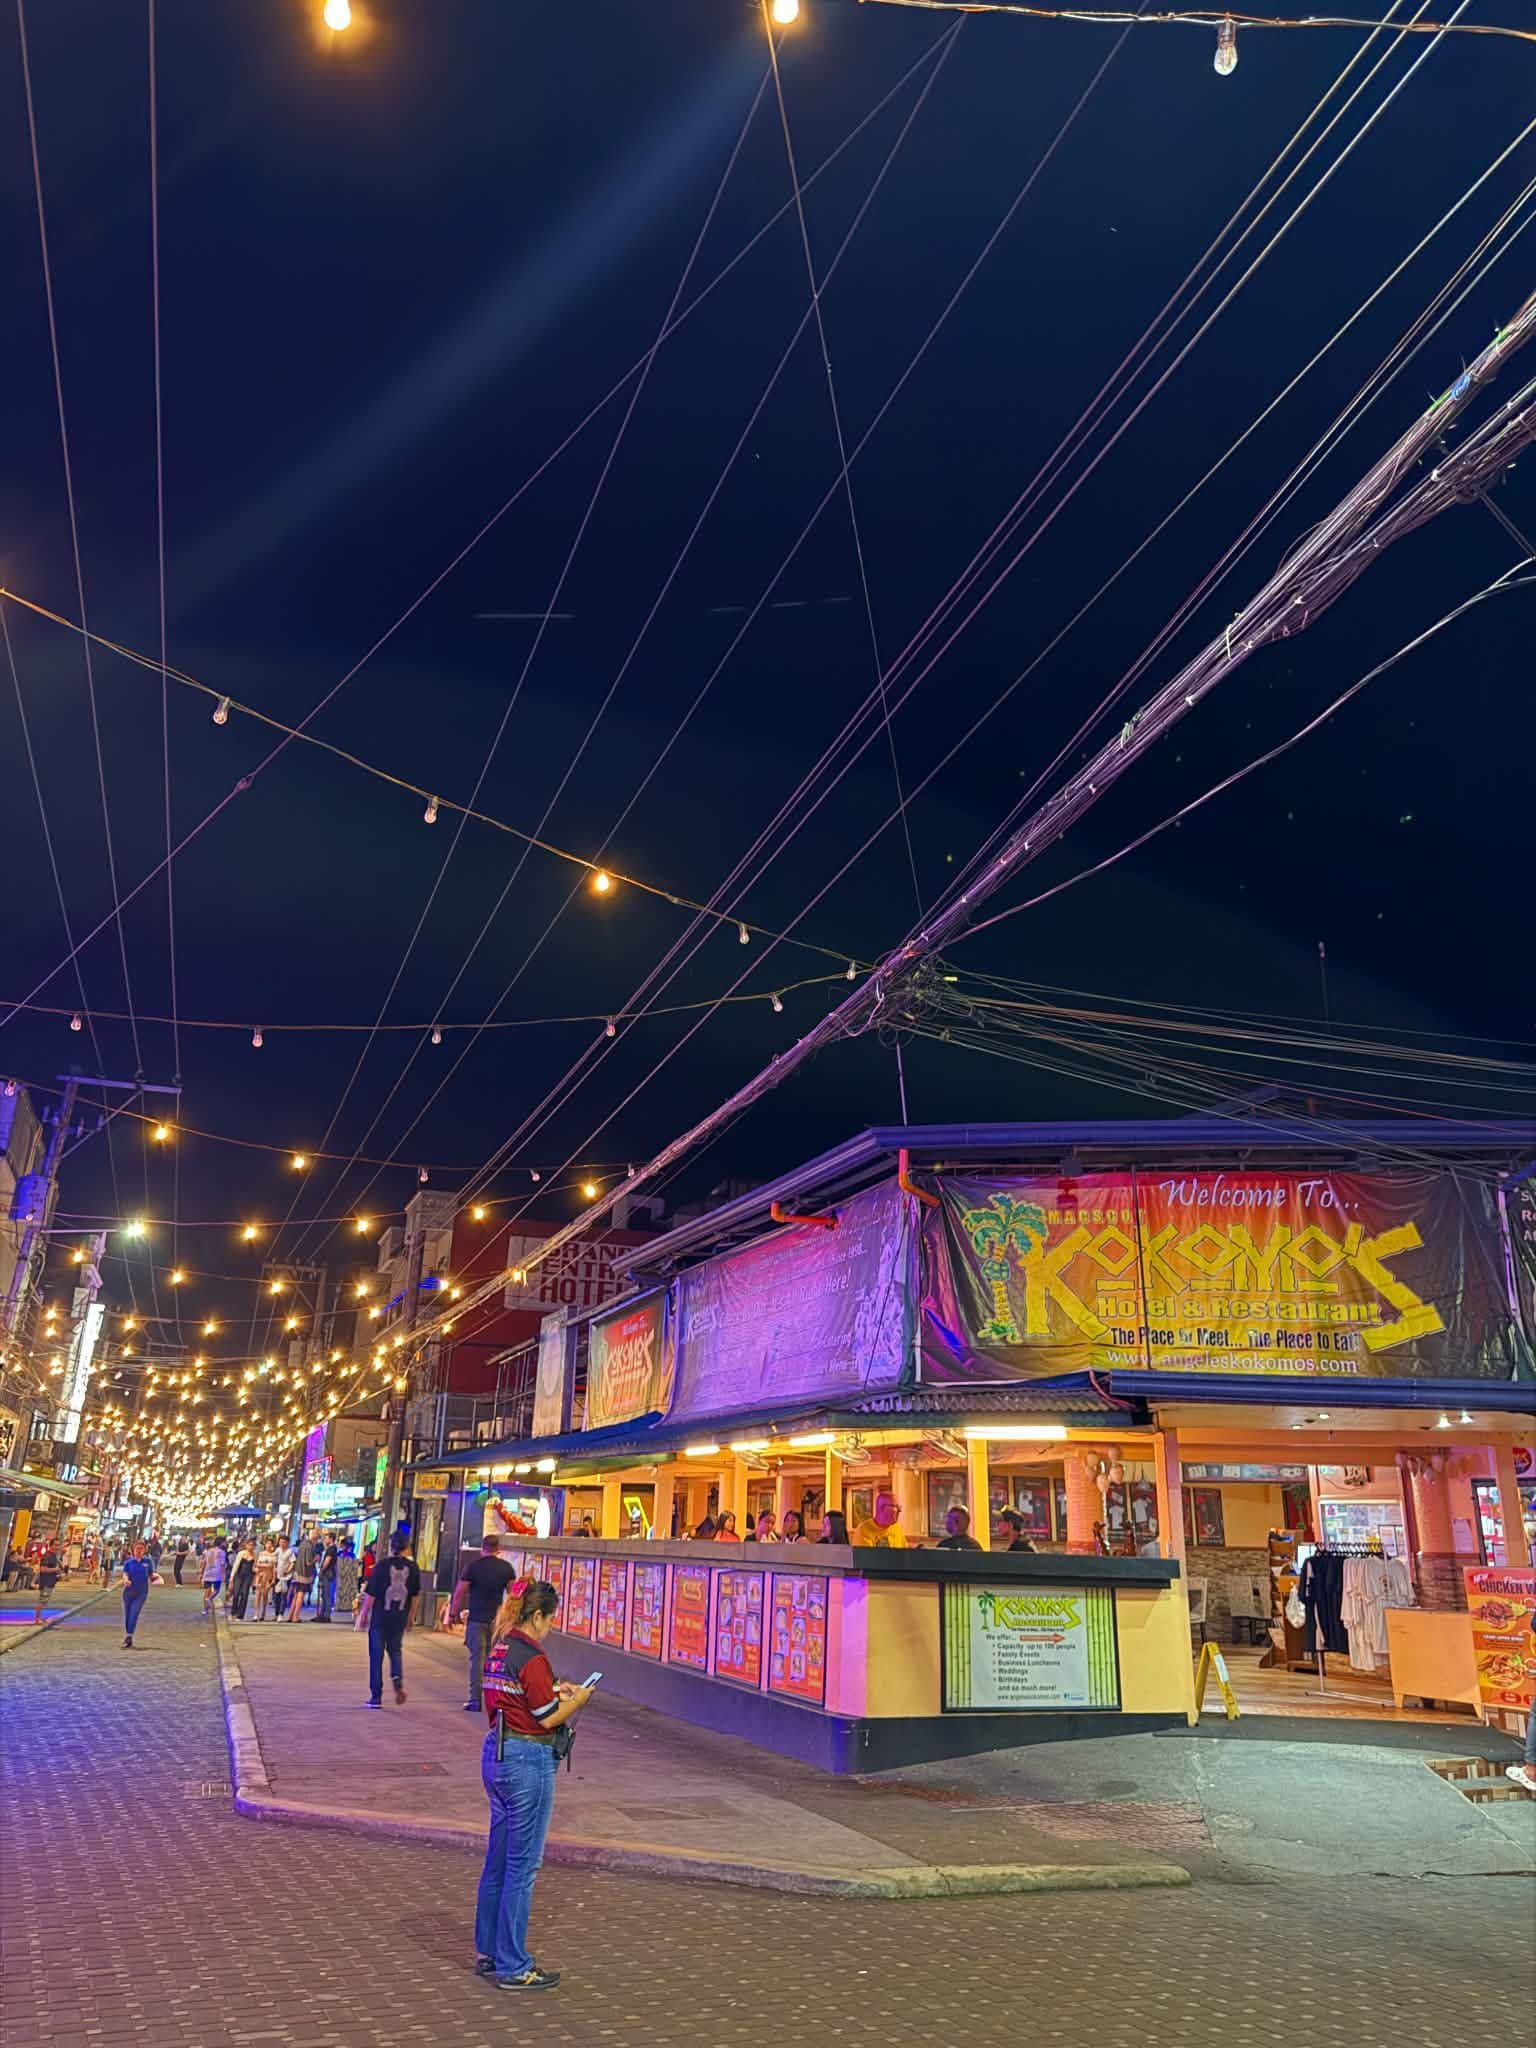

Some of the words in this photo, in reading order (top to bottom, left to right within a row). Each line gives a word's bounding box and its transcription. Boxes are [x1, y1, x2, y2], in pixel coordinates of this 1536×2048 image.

[1159, 1175, 1286, 1208] Welcome
[1096, 1295, 1177, 1318] Hotel
[1183, 1299, 1205, 1318] &
[1210, 1296, 1384, 1325] Restaurant
[1110, 1327, 1135, 1345] The
[1138, 1326, 1175, 1346] Pace
[1196, 1327, 1243, 1347] Meet...
[1247, 1329, 1272, 1349] The
[1276, 1329, 1313, 1350] Place
[1317, 1331, 1329, 1350] to
[54, 1463, 78, 1482] BAR
[1480, 1580, 1523, 1593] CHICKEN
[997, 1643, 1024, 1651] Capacity
[997, 1651, 1018, 1659] Family
[998, 1659, 1026, 1667] Business
[998, 1668, 1028, 1676] Weddings
[998, 1676, 1028, 1684] Birthdays
